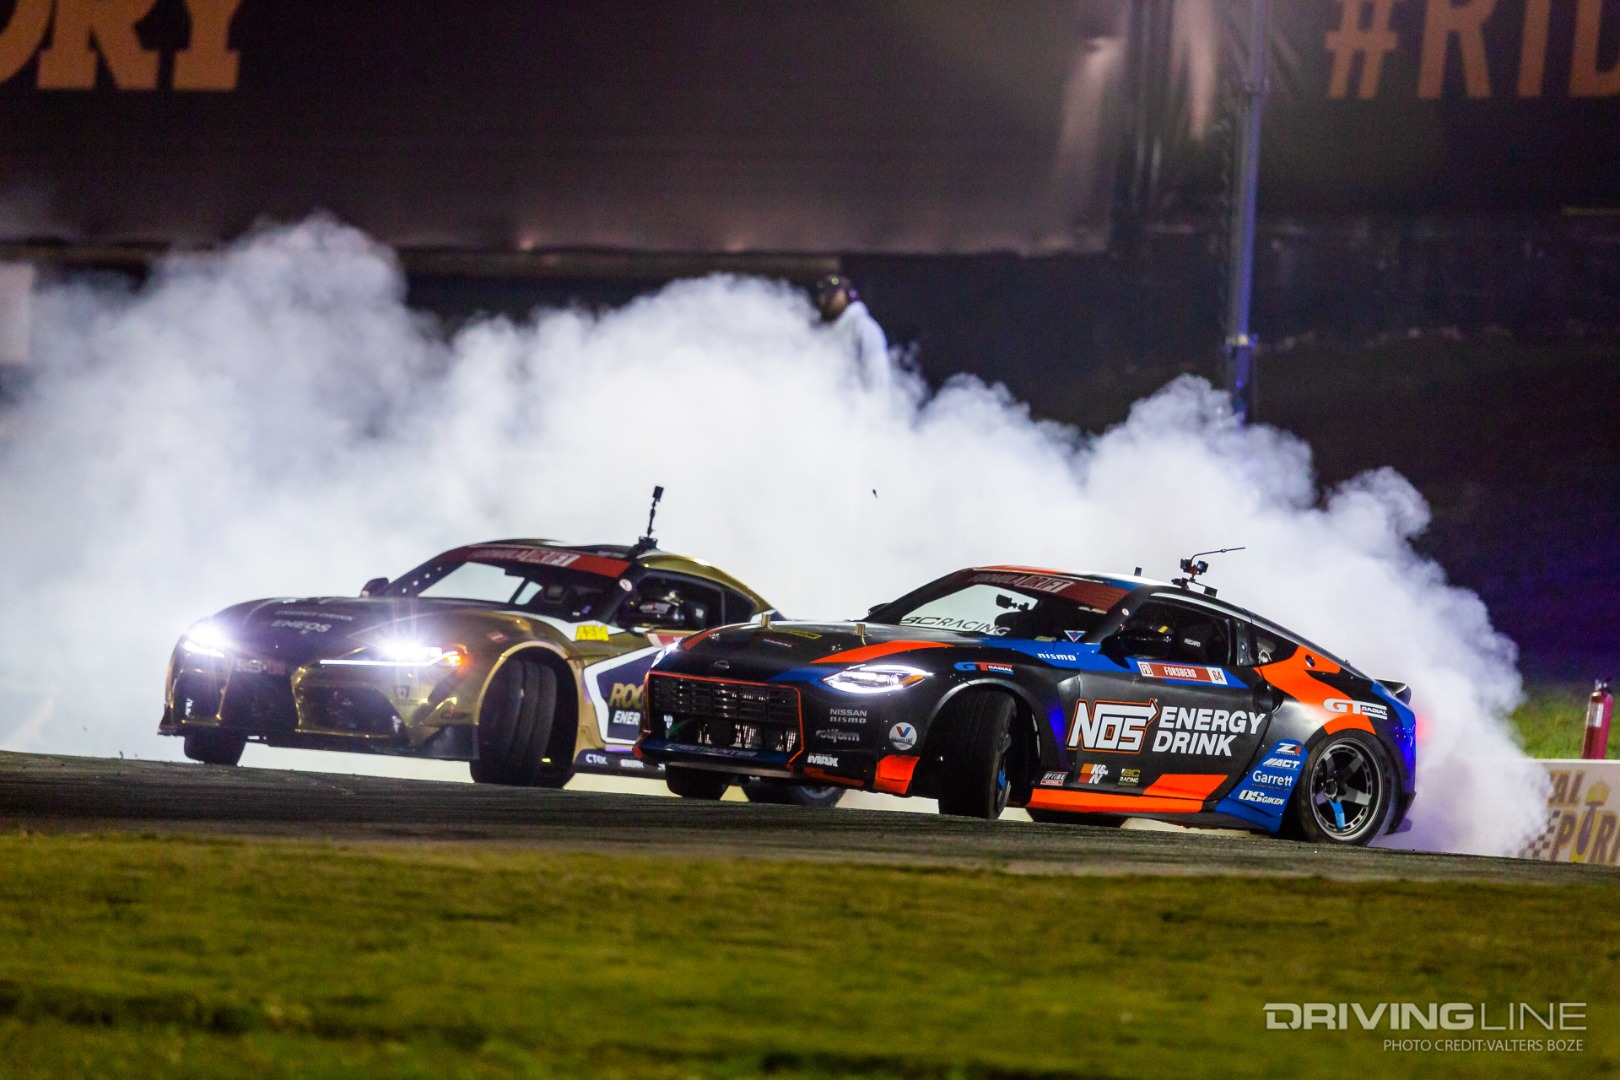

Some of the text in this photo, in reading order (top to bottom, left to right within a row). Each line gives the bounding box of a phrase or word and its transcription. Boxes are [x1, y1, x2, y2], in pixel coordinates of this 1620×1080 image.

[937, 618, 1011, 637] RACING
[1037, 652, 1077, 662] nismo
[953, 661, 990, 671] GT
[1211, 670, 1223, 682] 64
[829, 708, 867, 717] NISSAN
[1323, 698, 1388, 716] GT RADIAL
[1068, 700, 1266, 752] NOS ENERGY
[816, 728, 860, 743] rotiform
[1152, 730, 1237, 757] DRINK
[1119, 776, 1139, 784] RACING
[1252, 770, 1293, 786] Garrett
